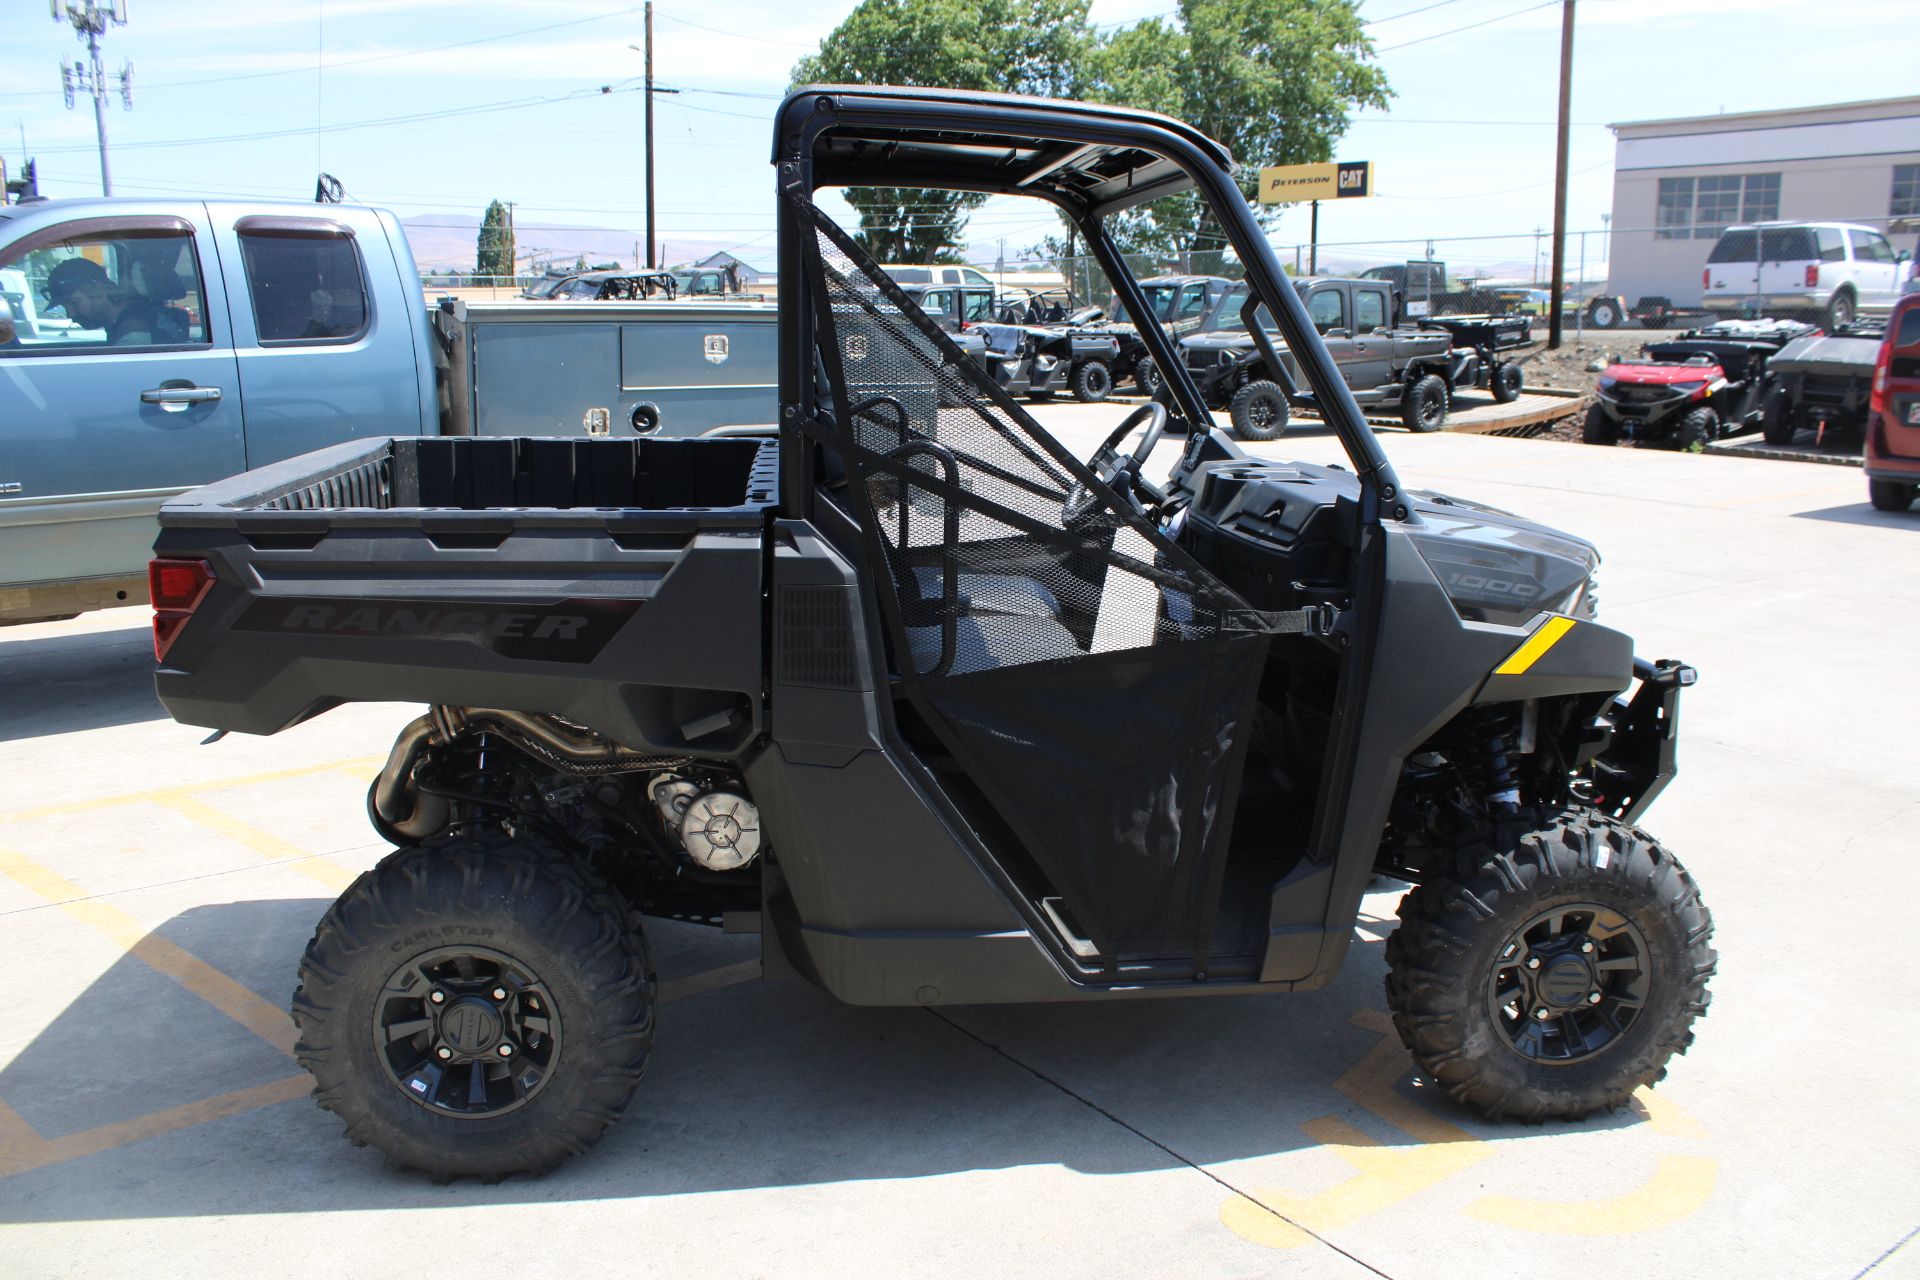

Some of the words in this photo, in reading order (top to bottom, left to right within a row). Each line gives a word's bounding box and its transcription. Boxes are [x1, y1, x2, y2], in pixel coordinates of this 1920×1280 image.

[1271, 177, 1330, 190] PETERSON
[1340, 169, 1364, 189] CAT
[1449, 573, 1540, 596] 1000
[281, 604, 590, 640] RANGER
